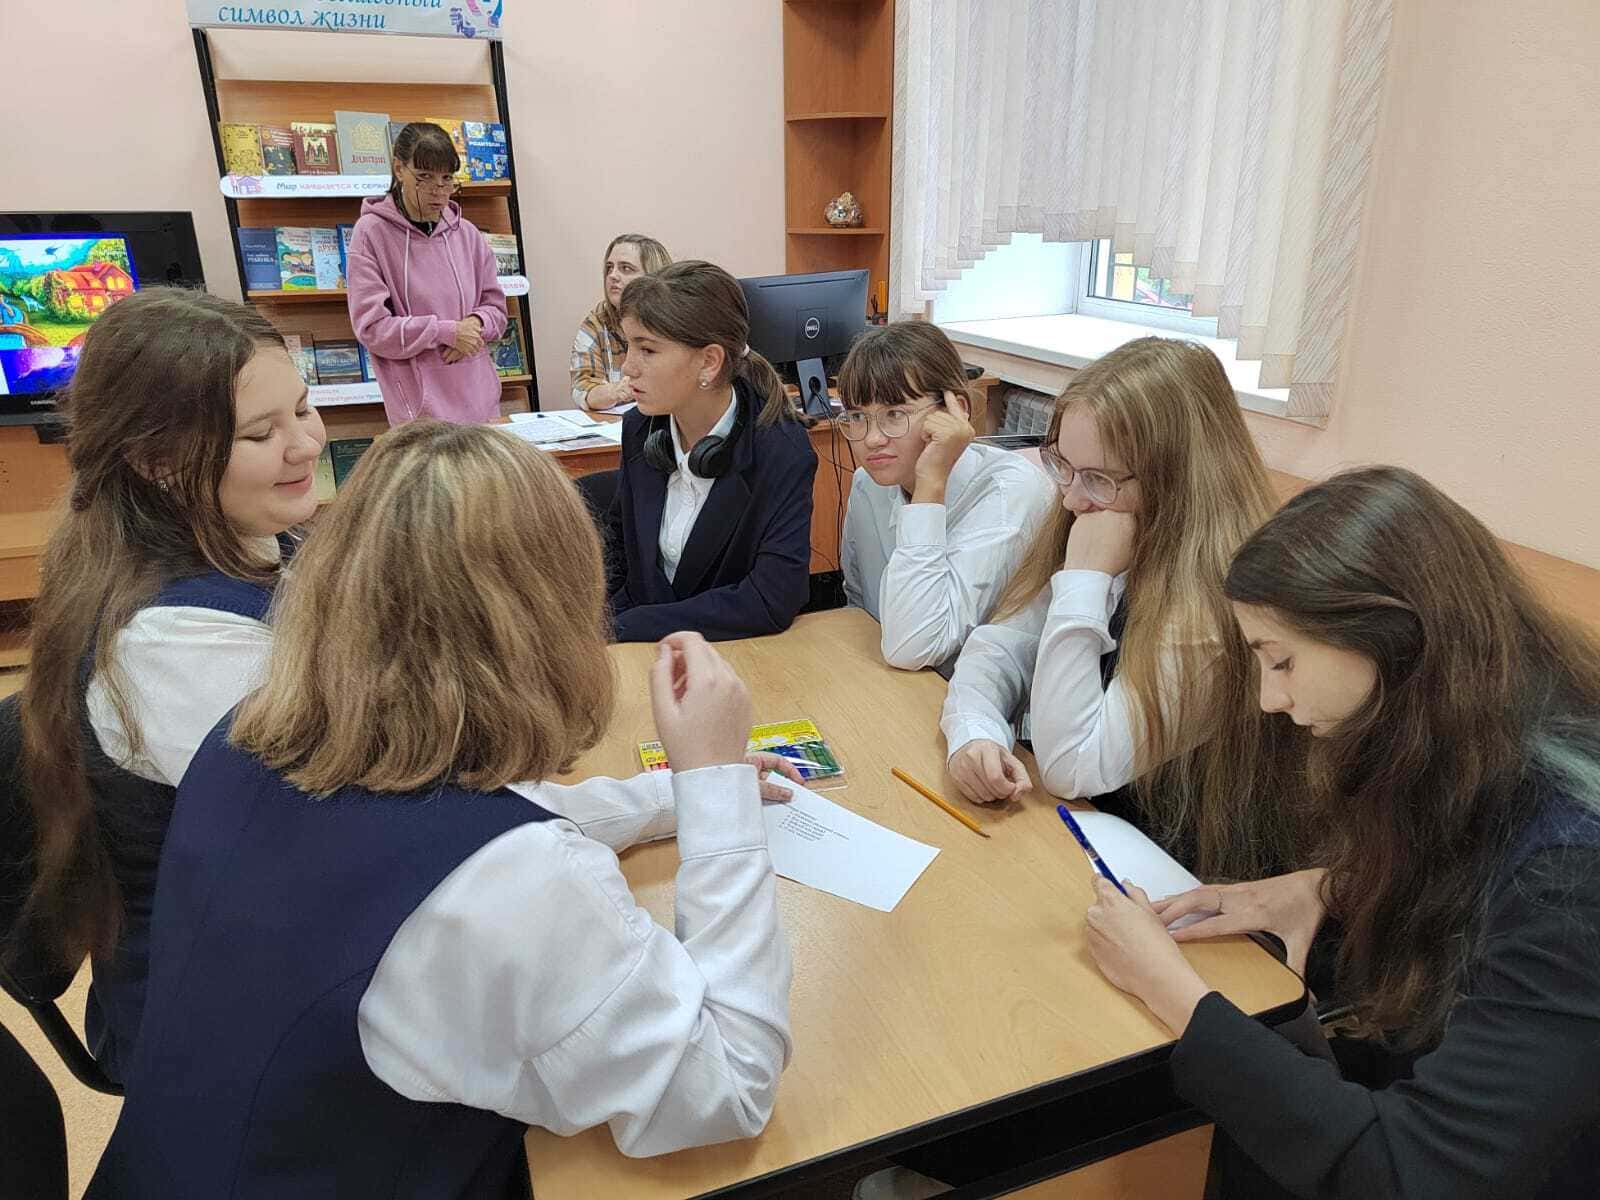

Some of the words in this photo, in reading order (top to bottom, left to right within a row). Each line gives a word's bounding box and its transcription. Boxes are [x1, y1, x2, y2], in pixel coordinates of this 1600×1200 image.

[218, 6, 305, 25] символ
[312, 10, 386, 32] жизни
[276, 182, 297, 192] Мир
